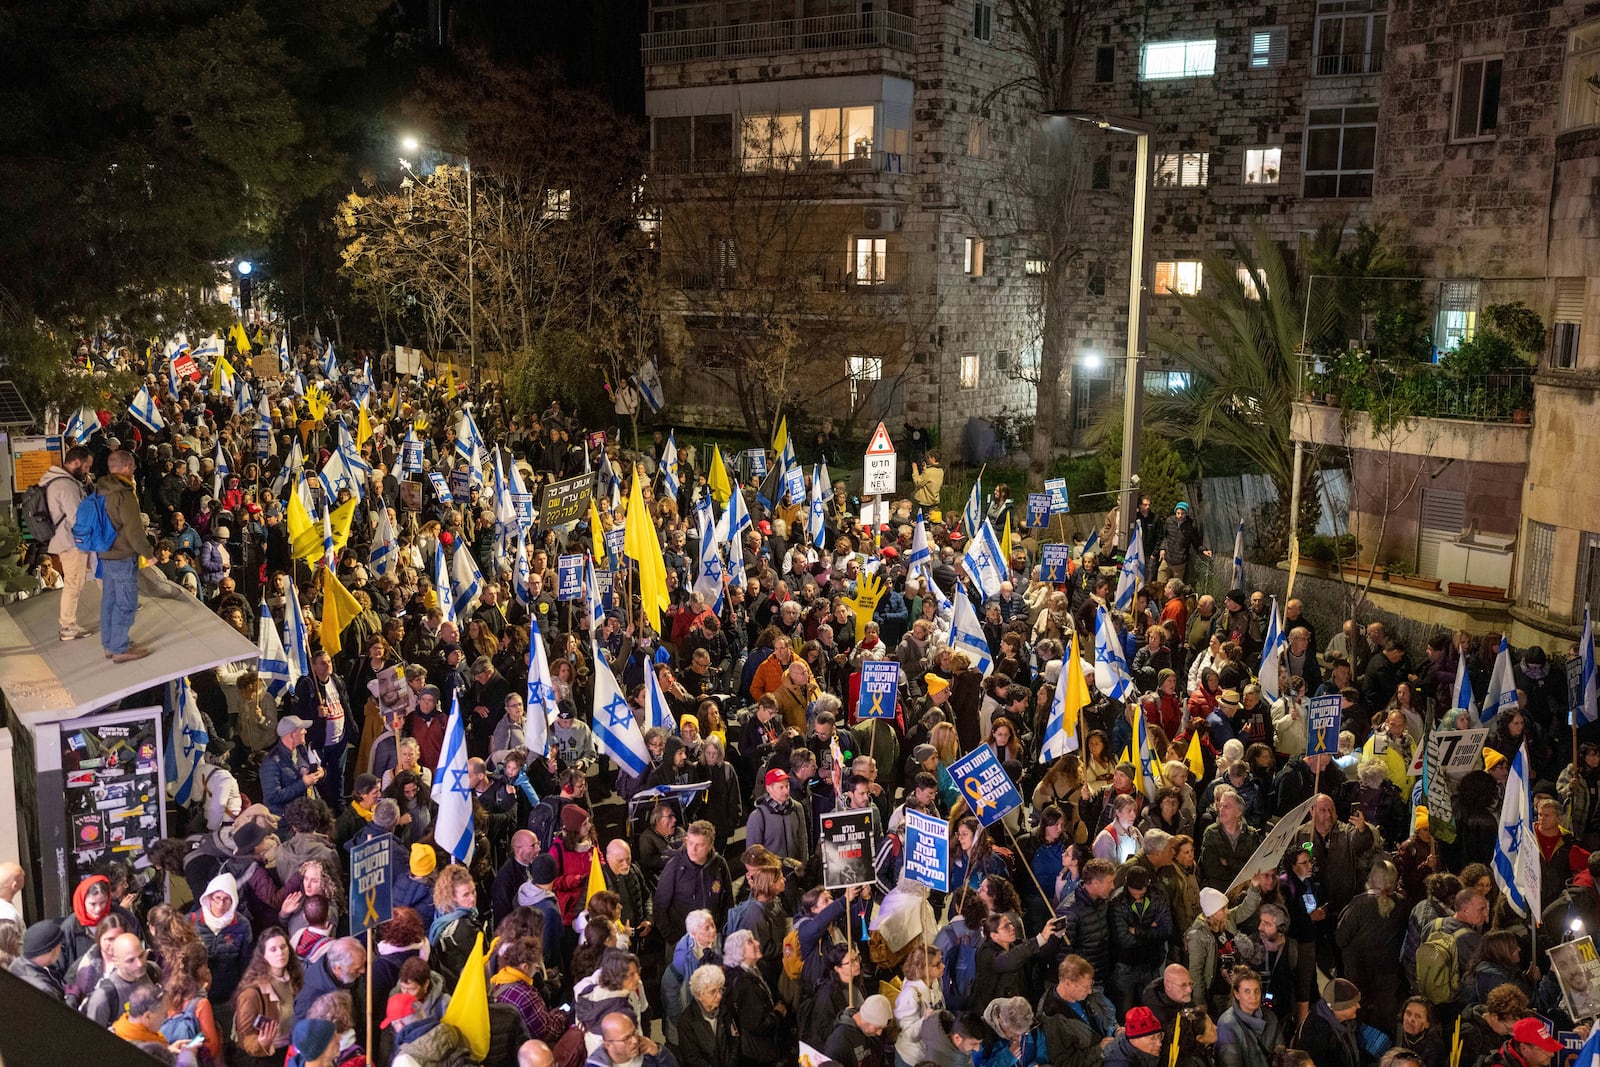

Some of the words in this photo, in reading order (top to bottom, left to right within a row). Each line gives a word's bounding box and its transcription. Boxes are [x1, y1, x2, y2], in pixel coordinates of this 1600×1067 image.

[864, 672, 896, 682] חופשיים
[867, 683, 891, 693] בארצנו
[1310, 706, 1339, 719] חופשיים
[1313, 717, 1334, 730] בארצנו
[970, 749, 992, 768] אנחנו
[954, 762, 974, 779] הרוב
[979, 764, 1001, 780] בעד
[979, 772, 1006, 795] עסקת
[976, 782, 1012, 808] חטופים
[908, 815, 923, 830] הרוב
[924, 822, 946, 837] אנחנו
[918, 832, 935, 847] בעד
[354, 850, 389, 879] חופשיים
[913, 850, 939, 868] חקירה
[907, 860, 945, 881] ממלכתית
[358, 868, 385, 894] בארצנו
